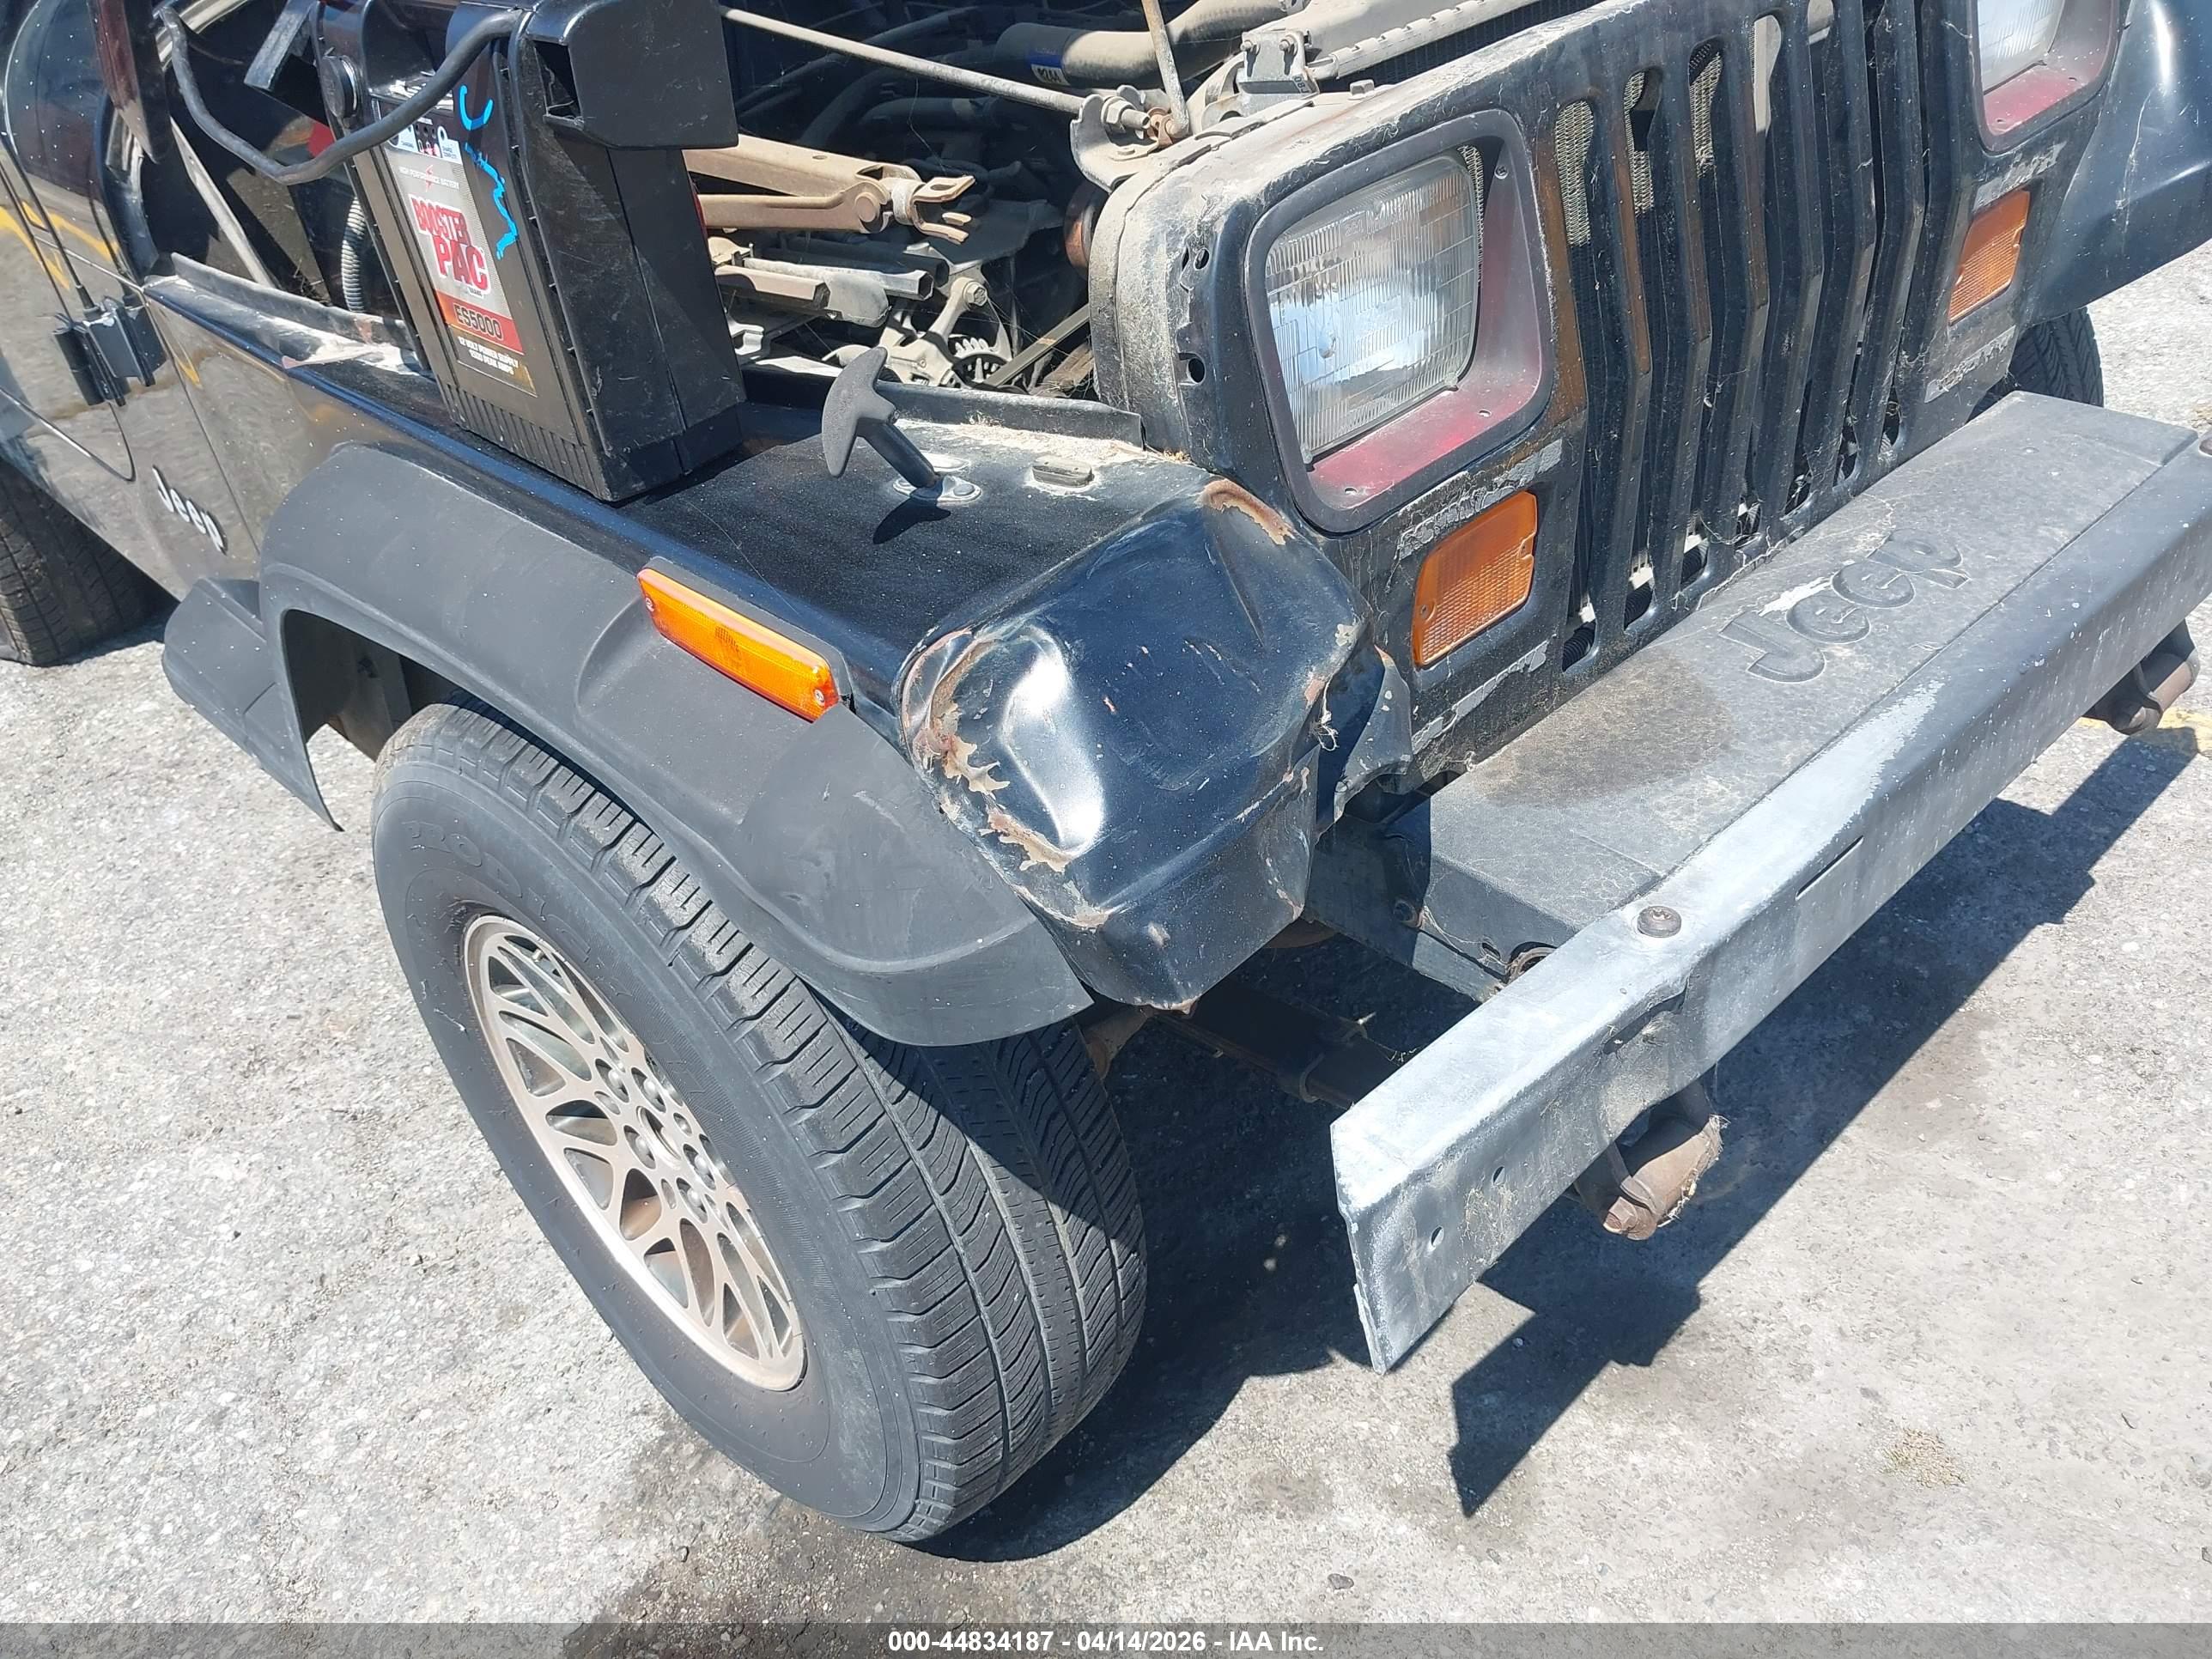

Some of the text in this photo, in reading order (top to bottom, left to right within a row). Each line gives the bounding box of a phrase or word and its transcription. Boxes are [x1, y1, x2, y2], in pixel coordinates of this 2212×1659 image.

[410, 197, 471, 246] BOOSTER
[432, 234, 489, 290] PAC
[453, 304, 503, 340] ES5000
[152, 465, 227, 555] Jeep
[1718, 527, 1972, 684] Jeep
